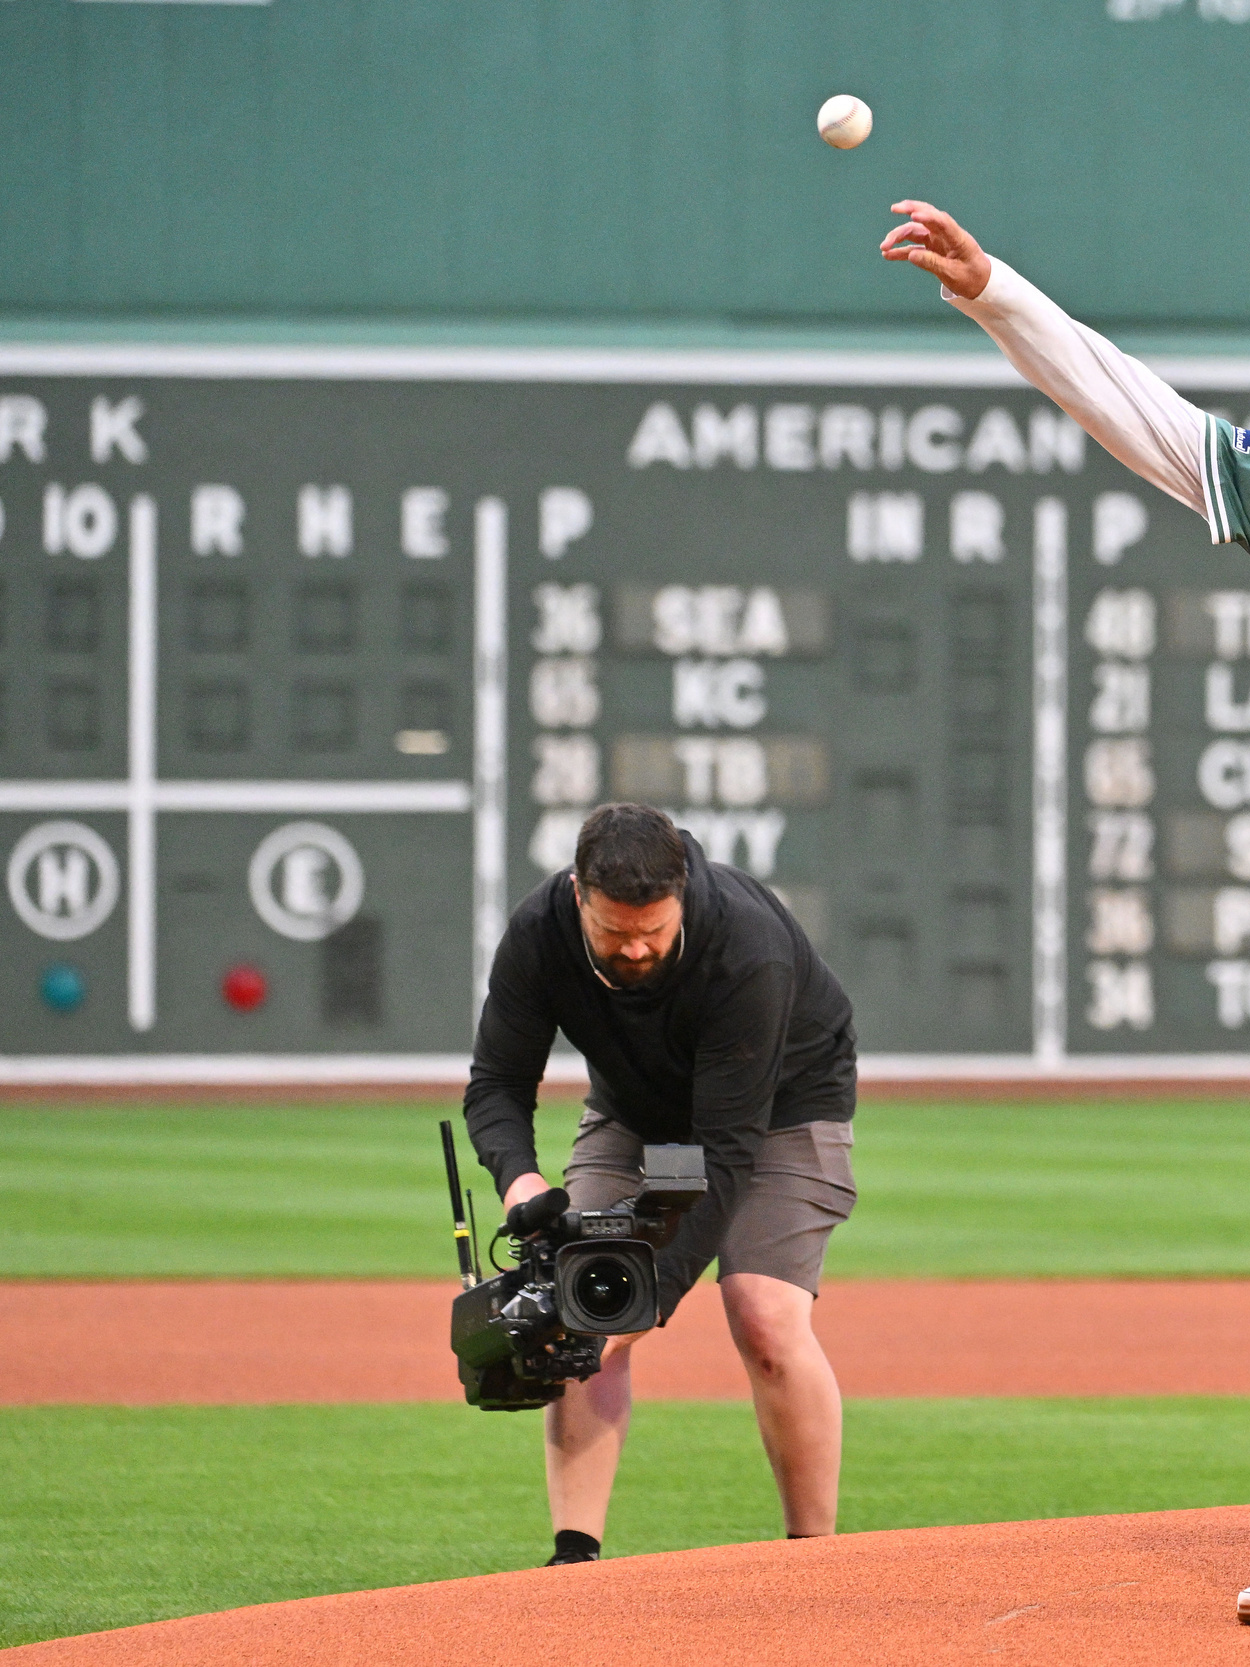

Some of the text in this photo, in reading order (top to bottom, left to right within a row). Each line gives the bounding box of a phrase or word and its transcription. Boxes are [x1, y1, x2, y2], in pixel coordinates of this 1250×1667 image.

[627, 401, 1086, 474] AMERICAN
[42, 484, 118, 559] 10
[190, 484, 447, 559] R H E
[539, 487, 592, 558] P
[847, 491, 1004, 562] IN R
[1093, 492, 1147, 564] P
[651, 585, 789, 655] SEA
[672, 659, 766, 728] KC
[673, 737, 769, 806] TB
[36, 846, 93, 920] H
[279, 846, 333, 916] E
